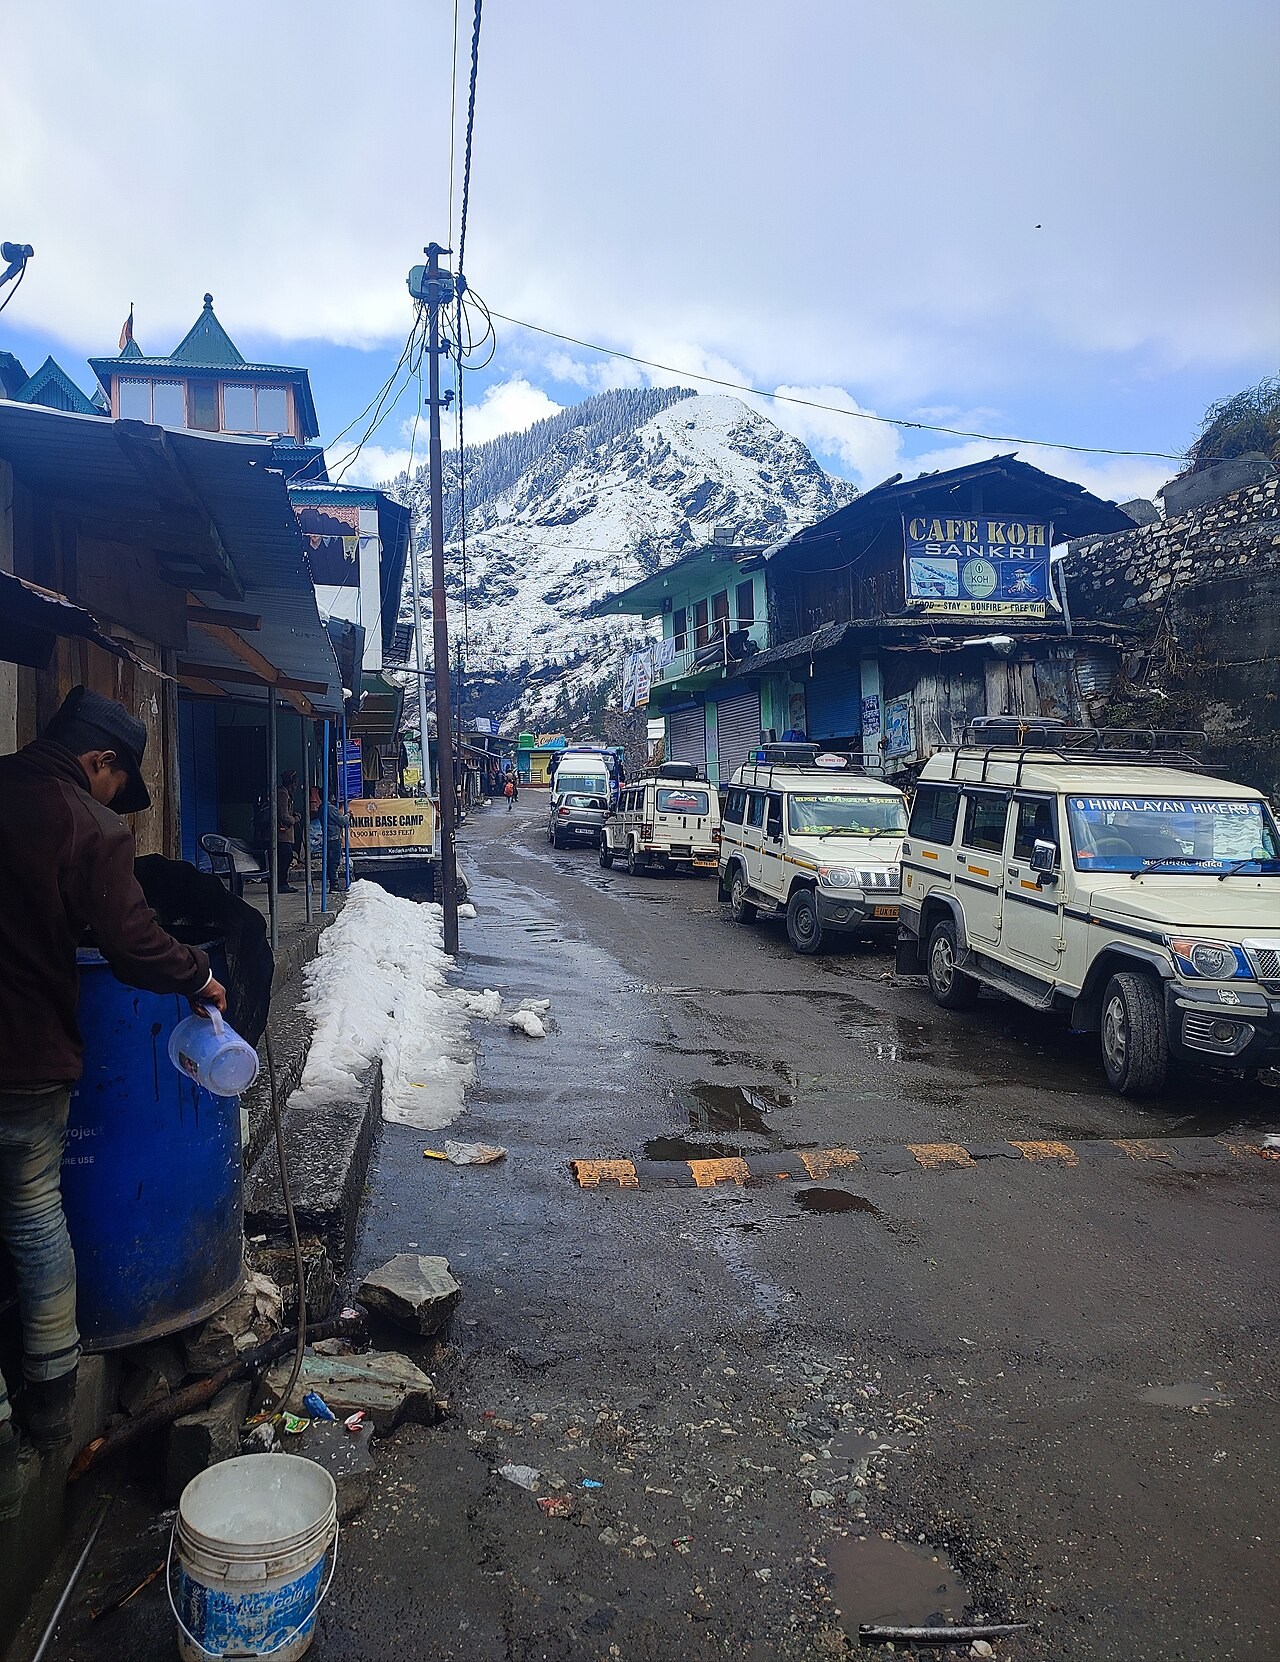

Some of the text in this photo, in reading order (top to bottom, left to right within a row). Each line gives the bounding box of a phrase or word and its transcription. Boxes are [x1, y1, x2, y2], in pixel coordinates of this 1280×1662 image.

[909, 517, 1046, 546] CAFE KOH
[925, 543, 1034, 559] SANKRI
[971, 575, 989, 584] KOH
[943, 601, 961, 611] STAY
[970, 602, 1002, 612] BONFIRE
[1010, 603, 1028, 613] FREE
[1029, 603, 1045, 613] Wifi
[1089, 799, 1251, 815] HIMALAYAN HIKERS
[375, 815, 398, 828] BASE
[399, 814, 424, 827] CAMP
[77, 1155, 95, 1165] USE
